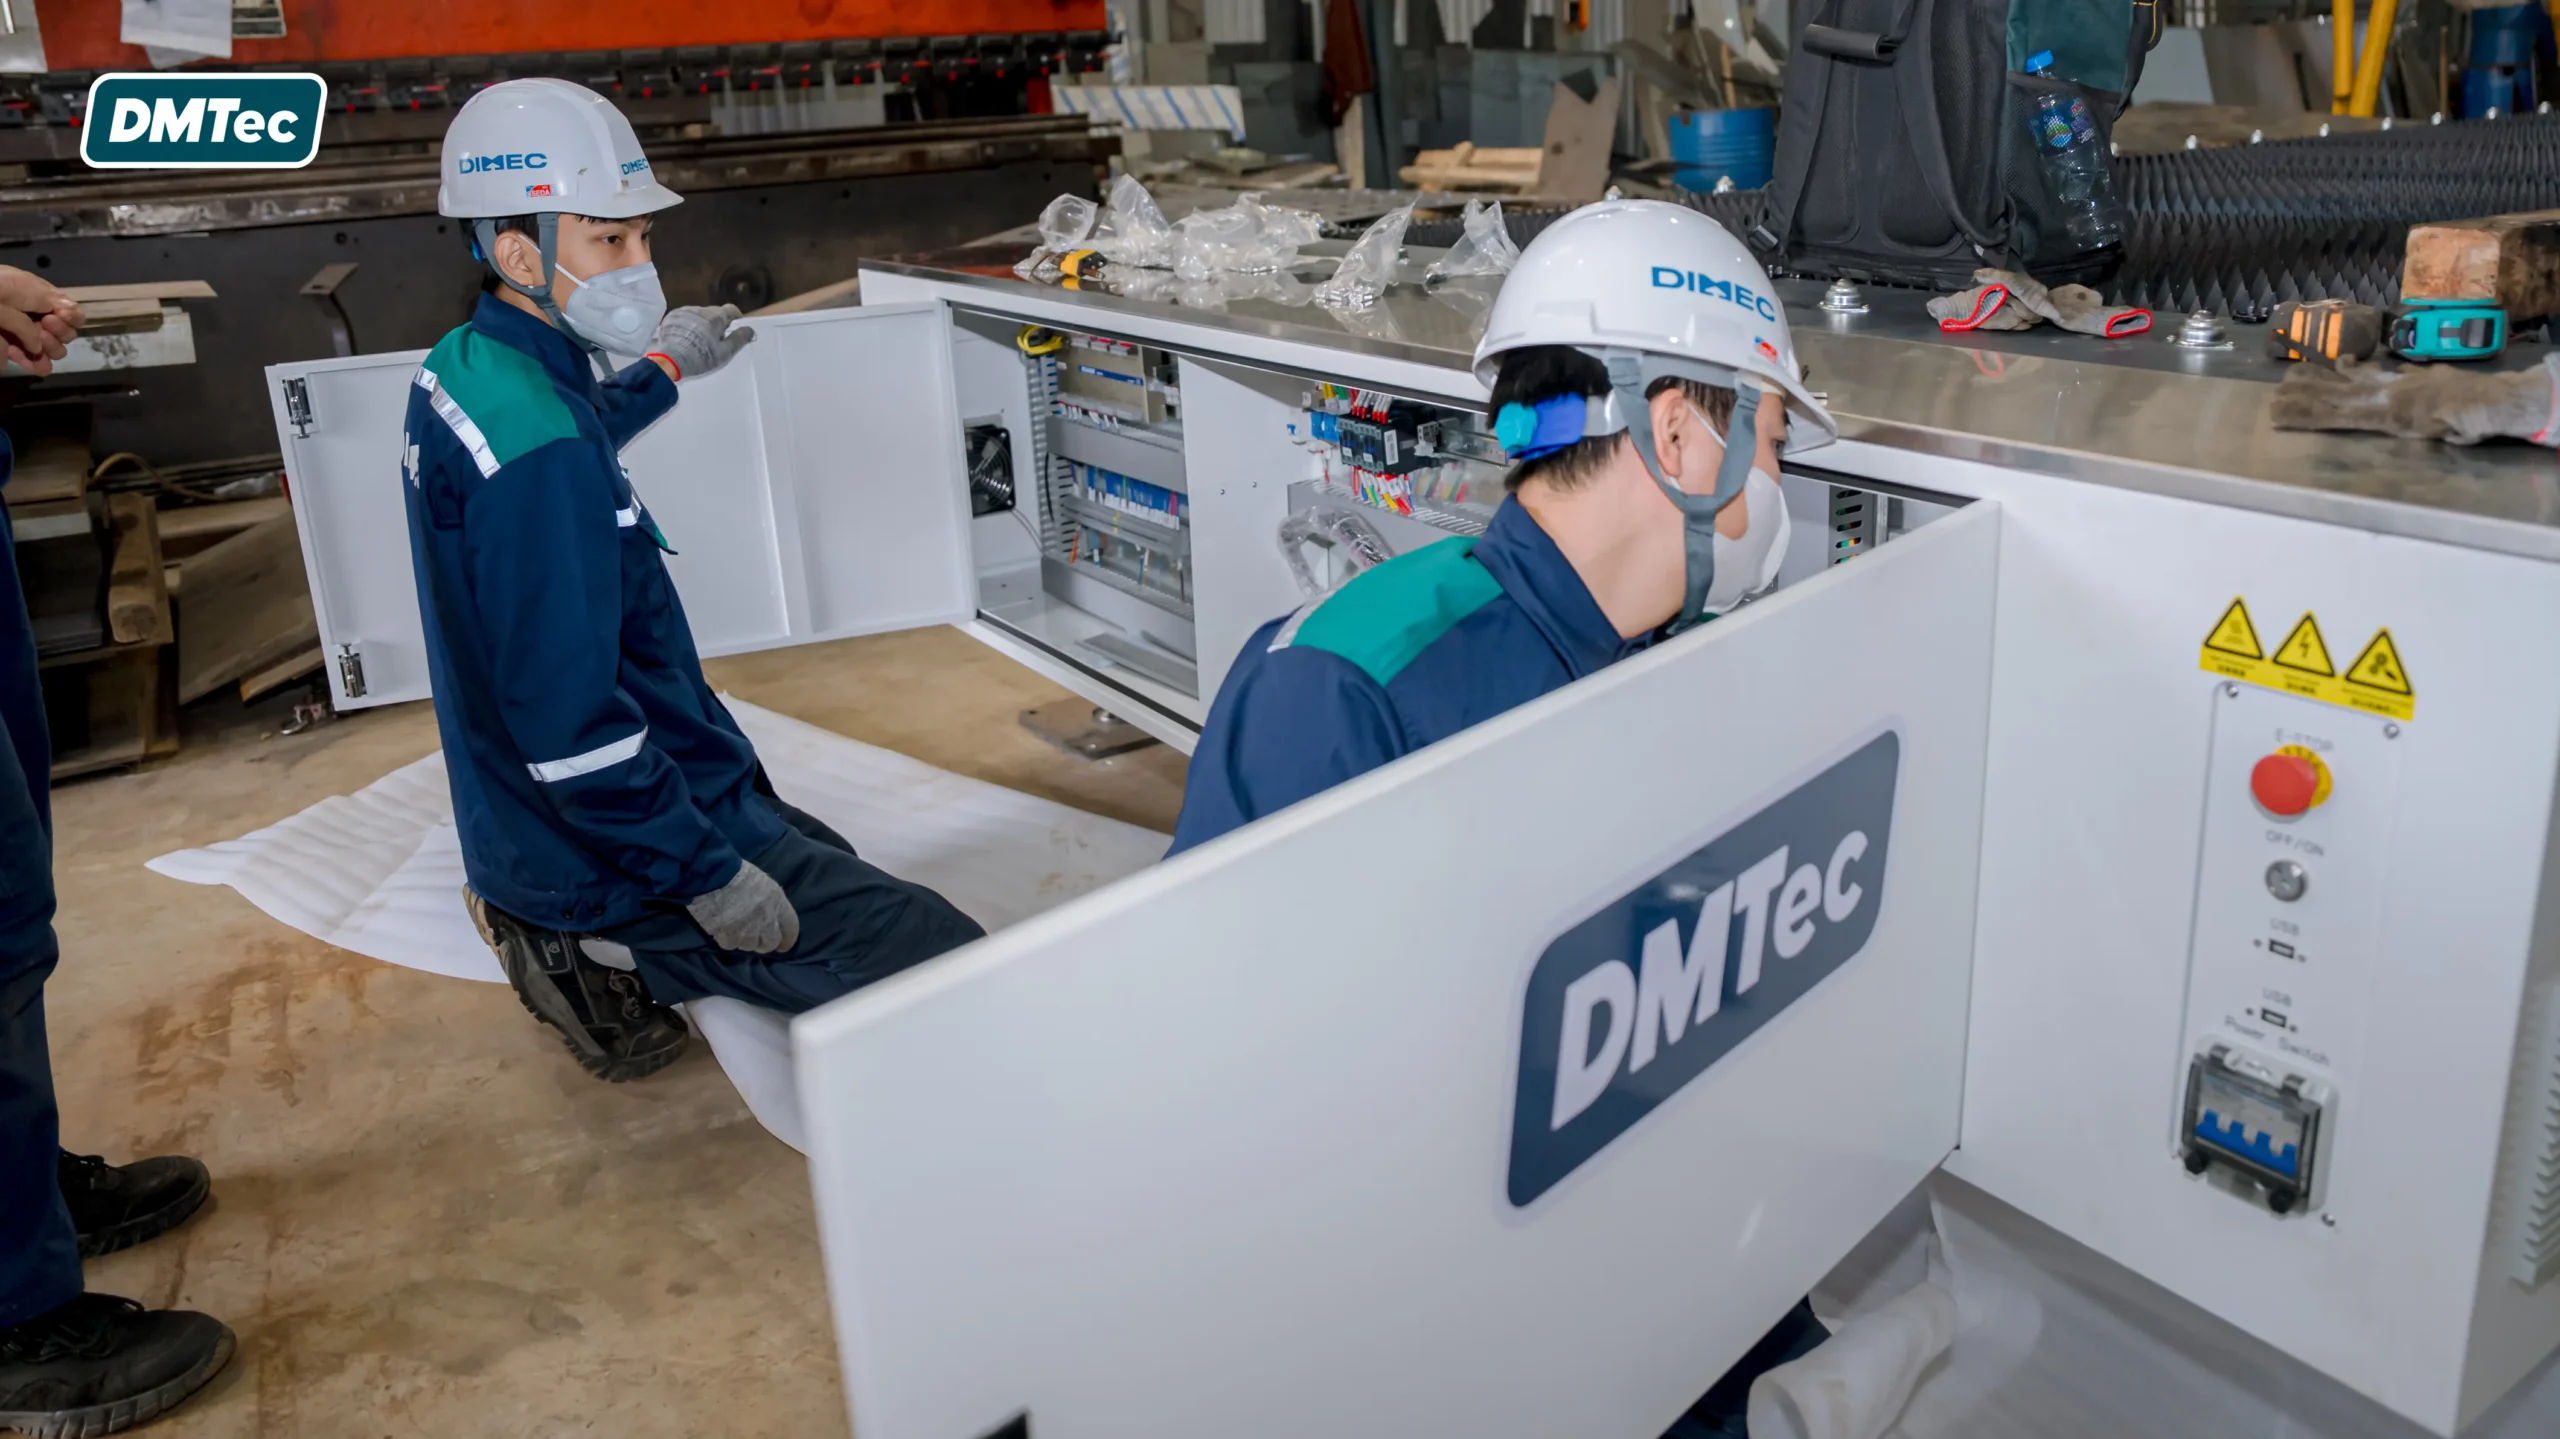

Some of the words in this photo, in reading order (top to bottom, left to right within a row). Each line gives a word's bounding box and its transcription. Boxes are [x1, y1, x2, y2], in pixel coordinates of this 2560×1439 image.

[459, 153, 547, 174] DIMEC
[1652, 267, 1775, 322] DIMEC
[1551, 830, 1868, 1131] DMTec
